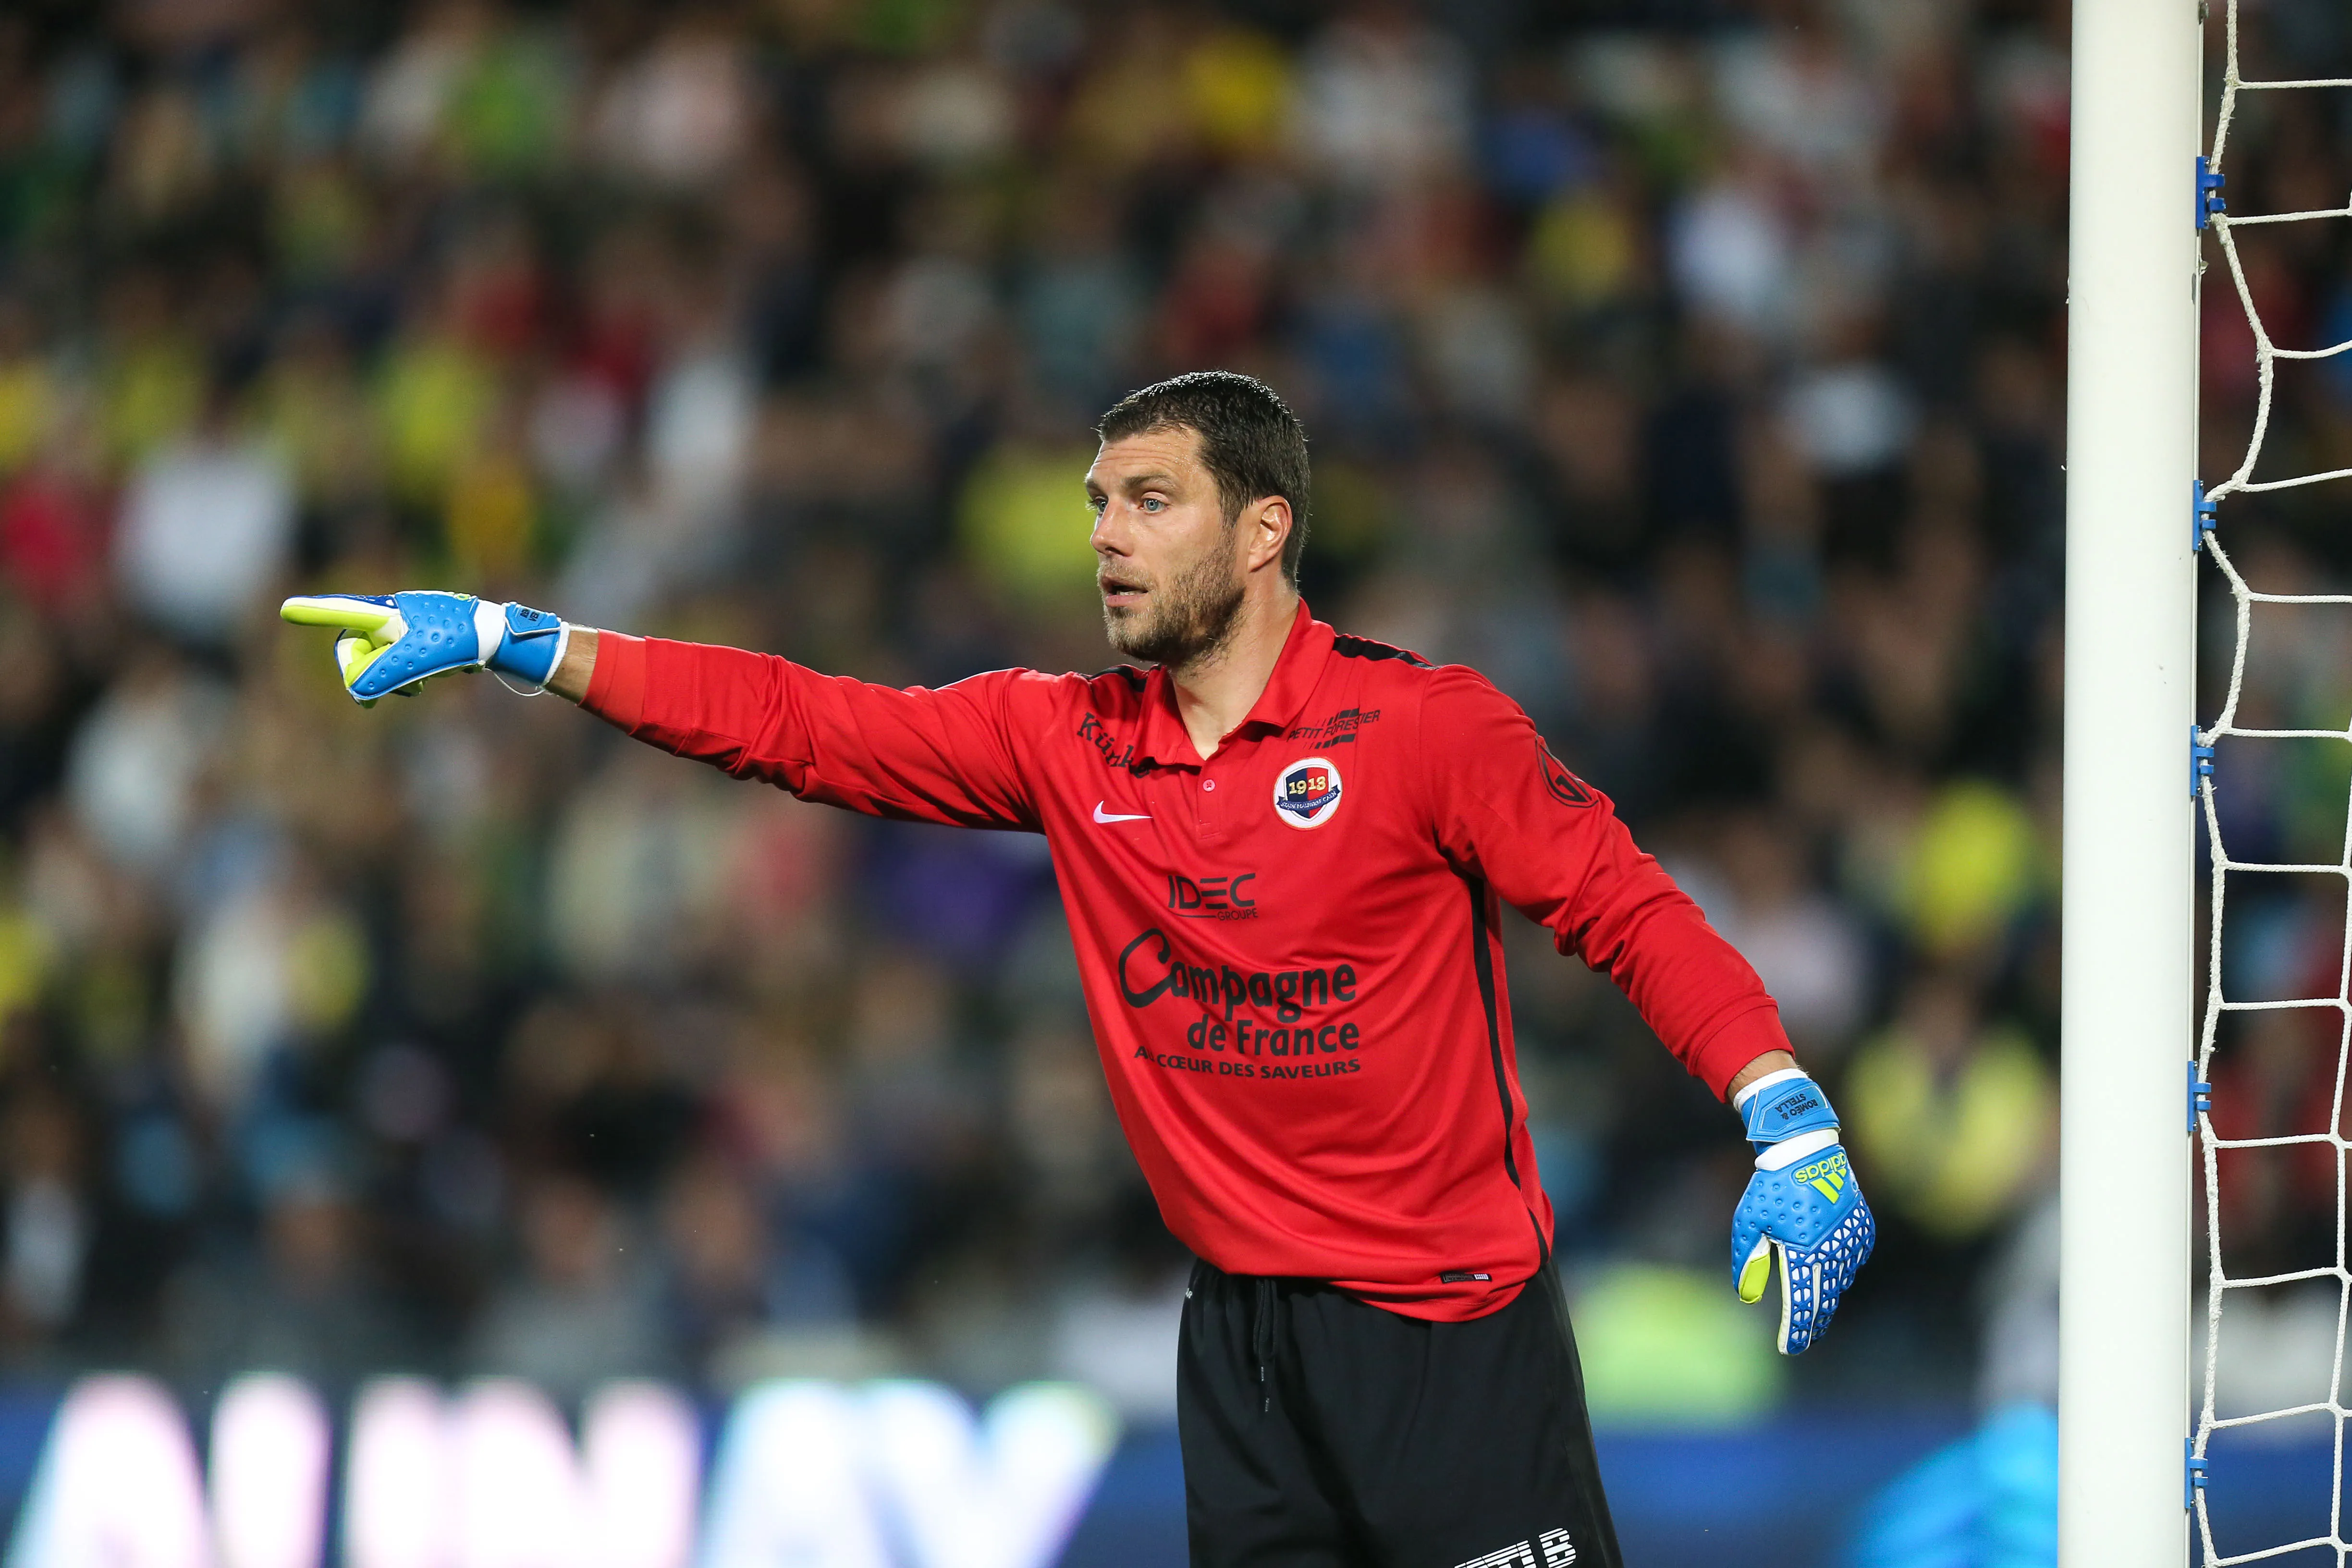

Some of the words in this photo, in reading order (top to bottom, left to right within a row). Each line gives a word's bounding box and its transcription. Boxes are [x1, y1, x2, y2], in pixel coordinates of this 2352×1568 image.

[1287, 727, 1323, 742] PETIT
[1323, 710, 1381, 738] FORESTIER
[1288, 776, 1326, 795] 1913
[1323, 791, 1337, 801] CAEN
[1168, 872, 1256, 909] IDEC
[1217, 908, 1259, 921] GROUPE
[1118, 928, 1357, 1023] Campagne
[1187, 1013, 1226, 1052] de
[1236, 1020, 1360, 1056] France
[1157, 1054, 1213, 1073] CŒUR
[1219, 1061, 1254, 1078] DES
[1261, 1057, 1360, 1079] SAVEURS
[1774, 1093, 1807, 1113] STELLA
[1789, 1099, 1818, 1116] ROMÉO
[1795, 1152, 1847, 1183] adidas
